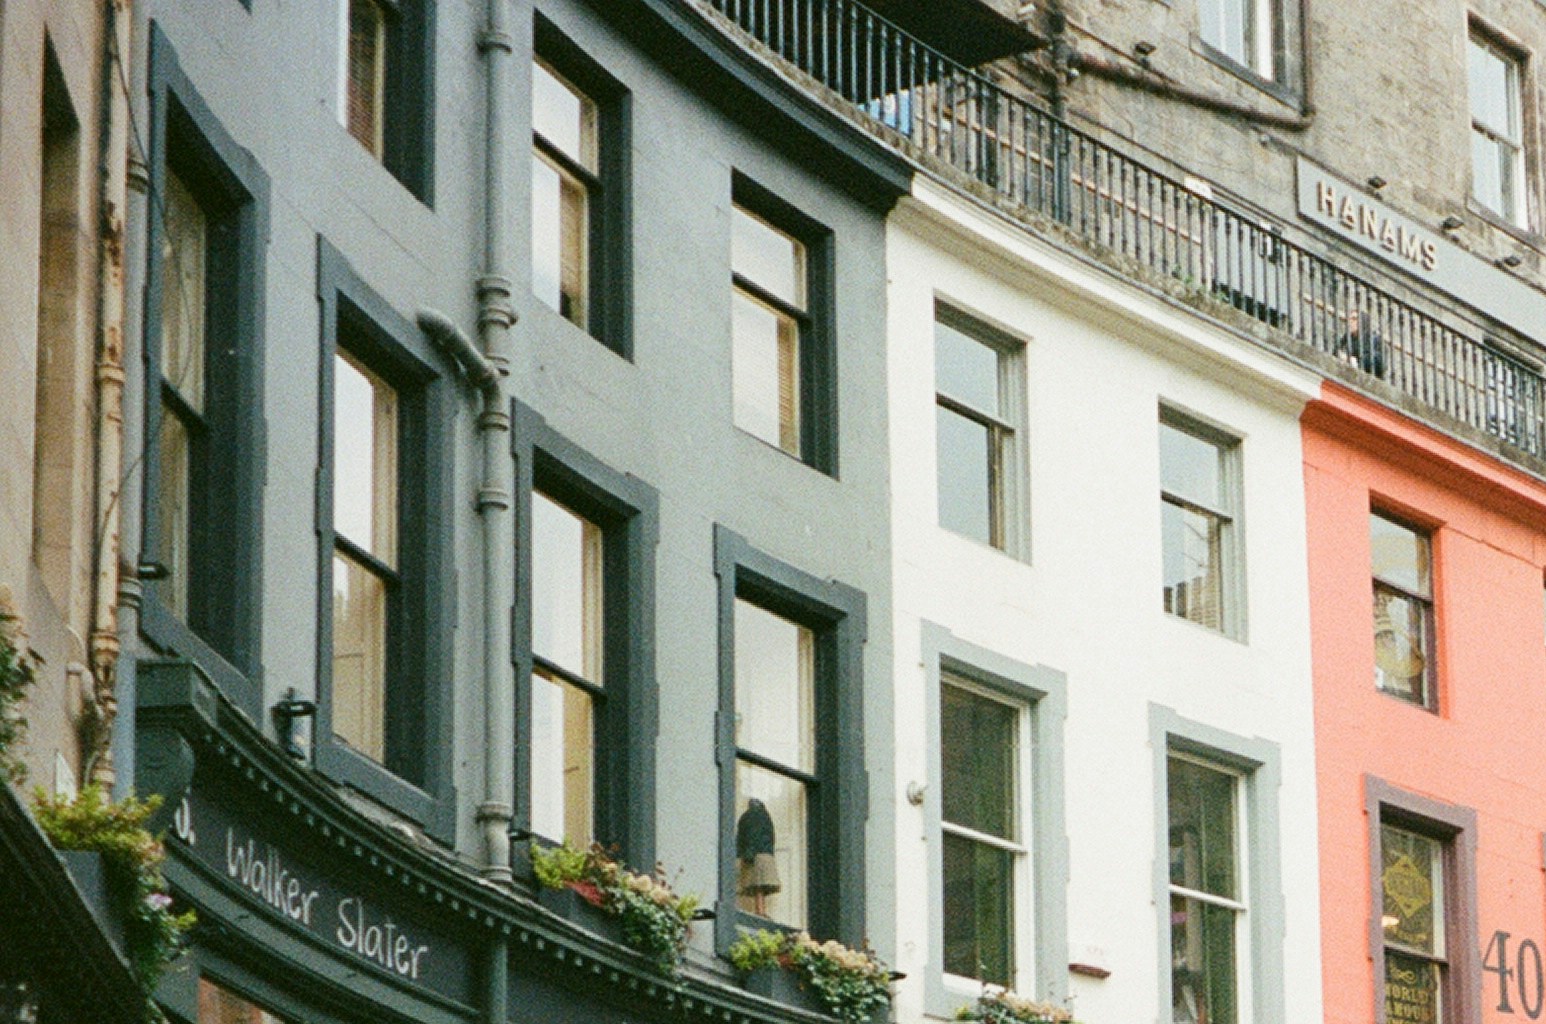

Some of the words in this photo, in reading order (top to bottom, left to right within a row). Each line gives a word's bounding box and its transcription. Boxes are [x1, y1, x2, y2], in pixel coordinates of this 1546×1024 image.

[1316, 180, 1436, 271] HANAMS
[226, 826, 319, 926] Walker
[335, 896, 428, 980] Slater
[1482, 930, 1544, 1021] 40
